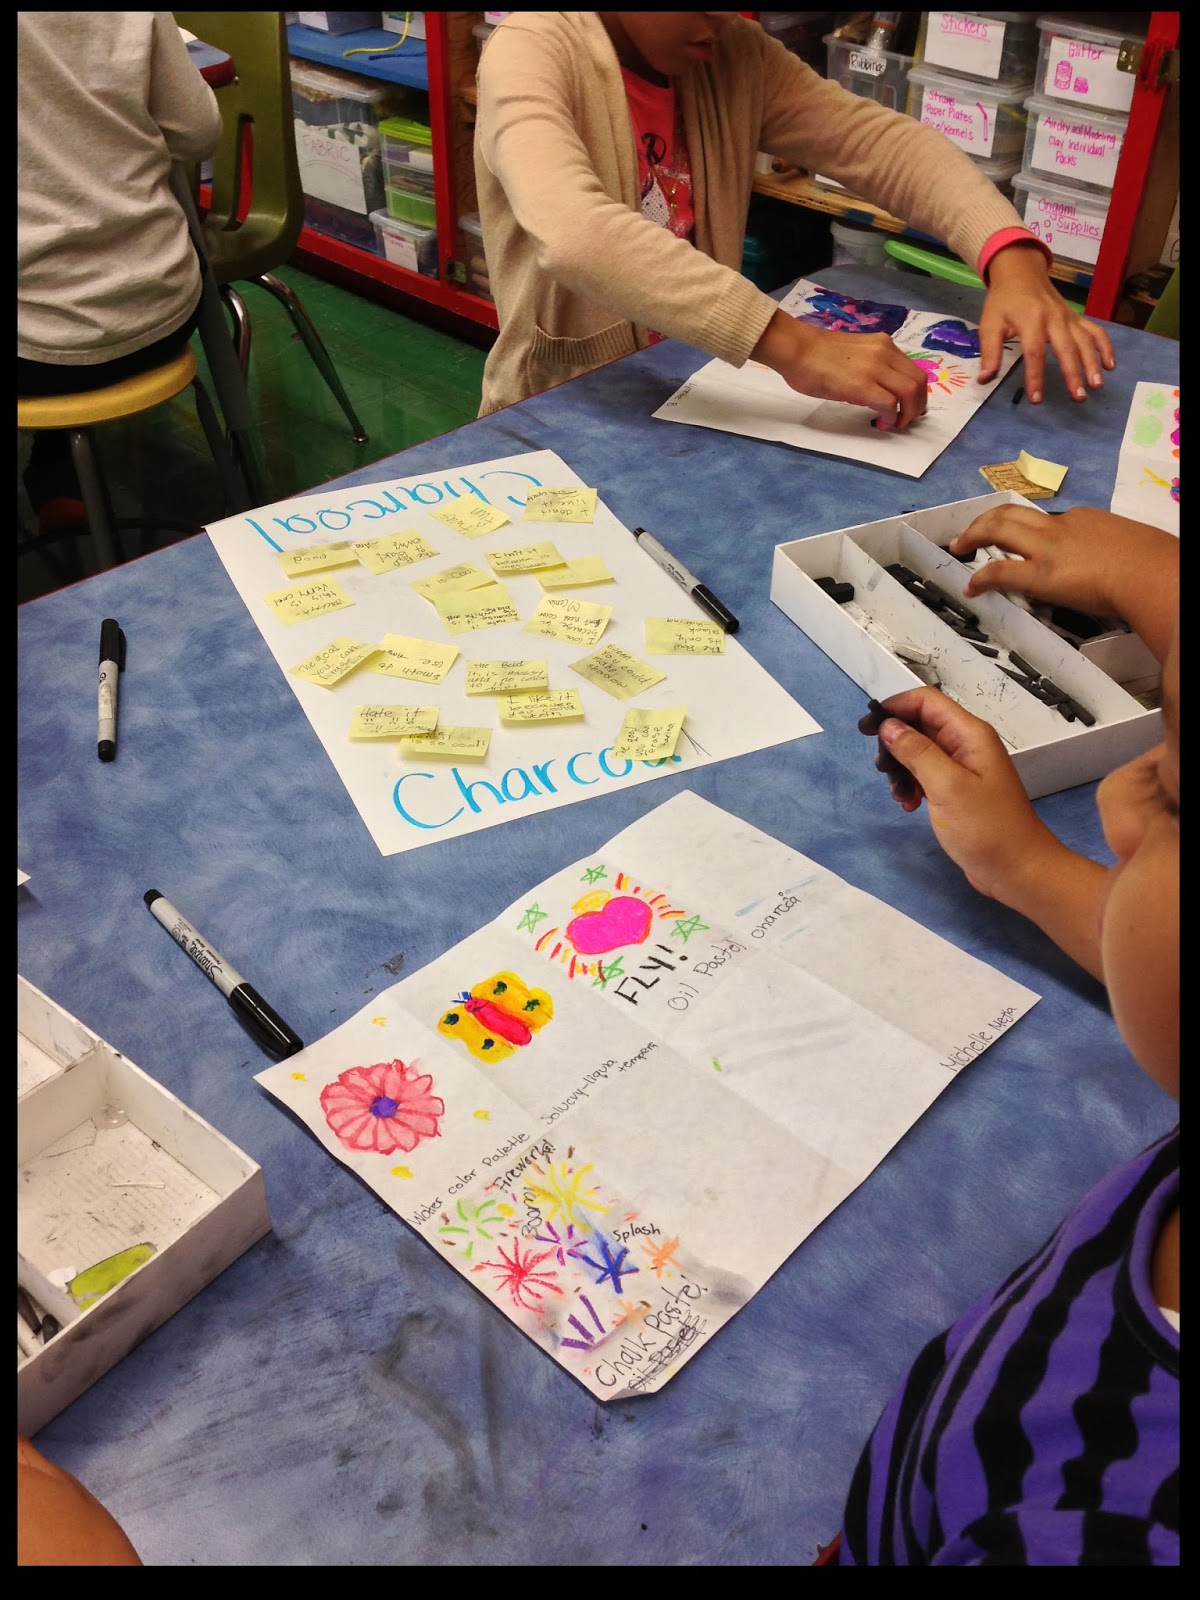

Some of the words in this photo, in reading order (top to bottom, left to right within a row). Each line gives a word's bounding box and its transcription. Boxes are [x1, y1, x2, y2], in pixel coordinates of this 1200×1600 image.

[942, 14, 988, 38] Stickers
[1069, 42, 1104, 60] Glitter
[948, 106, 973, 124] Plates
[303, 134, 351, 162] FABRIC
[1049, 135, 1064, 149] Clay
[1069, 139, 1105, 157] Individual
[1056, 151, 1076, 166] Packs
[1038, 198, 1075, 219] Origami
[1057, 219, 1099, 237] Supplies
[245, 470, 543, 552] Charcoal
[311, 591, 336, 601] this
[559, 622, 598, 636] because
[565, 635, 583, 644] love
[675, 634, 702, 644] only
[298, 661, 317, 673] The
[316, 644, 341, 664] good
[340, 645, 359, 659] can
[702, 646, 723, 654] The
[621, 665, 652, 684] could
[507, 694, 519, 704] I
[558, 692, 574, 701] it
[360, 708, 393, 717] Hate
[405, 707, 425, 717] it
[648, 726, 663, 754] erase
[392, 746, 682, 829] Charco
[614, 944, 688, 1006] FLY!
[667, 982, 700, 1011] Oil
[693, 938, 748, 977] Pastel
[618, 1041, 659, 1073] tempera
[939, 1031, 993, 1073] Michelle
[408, 1197, 443, 1227] Water
[448, 1170, 477, 1196] color
[595, 1332, 656, 1387] Chalk
